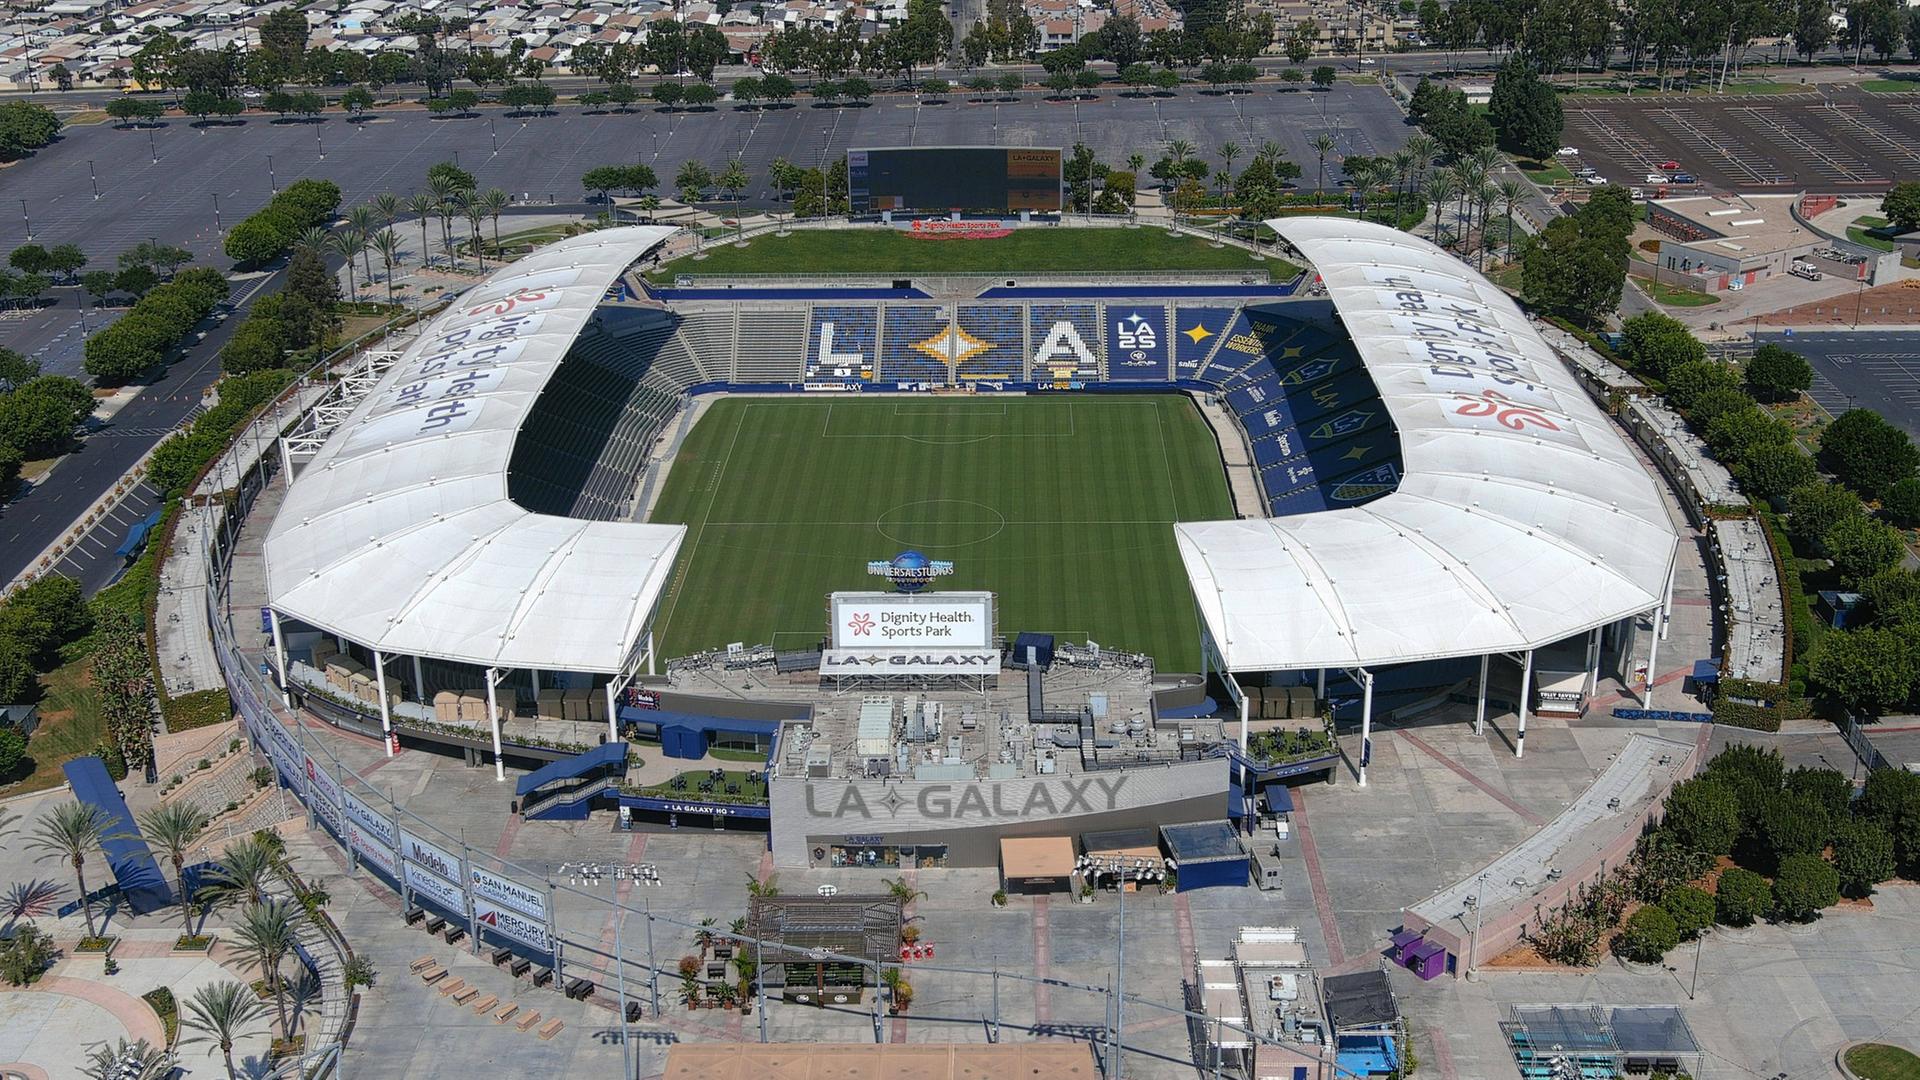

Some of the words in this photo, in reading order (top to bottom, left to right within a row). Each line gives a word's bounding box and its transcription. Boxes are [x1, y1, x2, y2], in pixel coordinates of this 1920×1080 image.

[1118, 322, 1155, 336] LA
[867, 565, 916, 577] UNIVERSAL
[917, 565, 954, 577] STUDIOS
[881, 612, 927, 626] Dignity
[929, 611, 973, 622] Health
[881, 626, 922, 639] Sports
[925, 626, 952, 636] Park
[827, 655, 860, 665] LA
[888, 655, 995, 665] GALAXY
[805, 783, 871, 818] LA
[916, 775, 1129, 818] GALAXY
[684, 805, 714, 814] GALAXY
[412, 842, 448, 875] Modelo
[482, 876, 502, 891] SAN
[503, 884, 543, 907] MANUEL
[497, 911, 545, 938] MERCURY
[497, 921, 547, 948] INSURANCE
